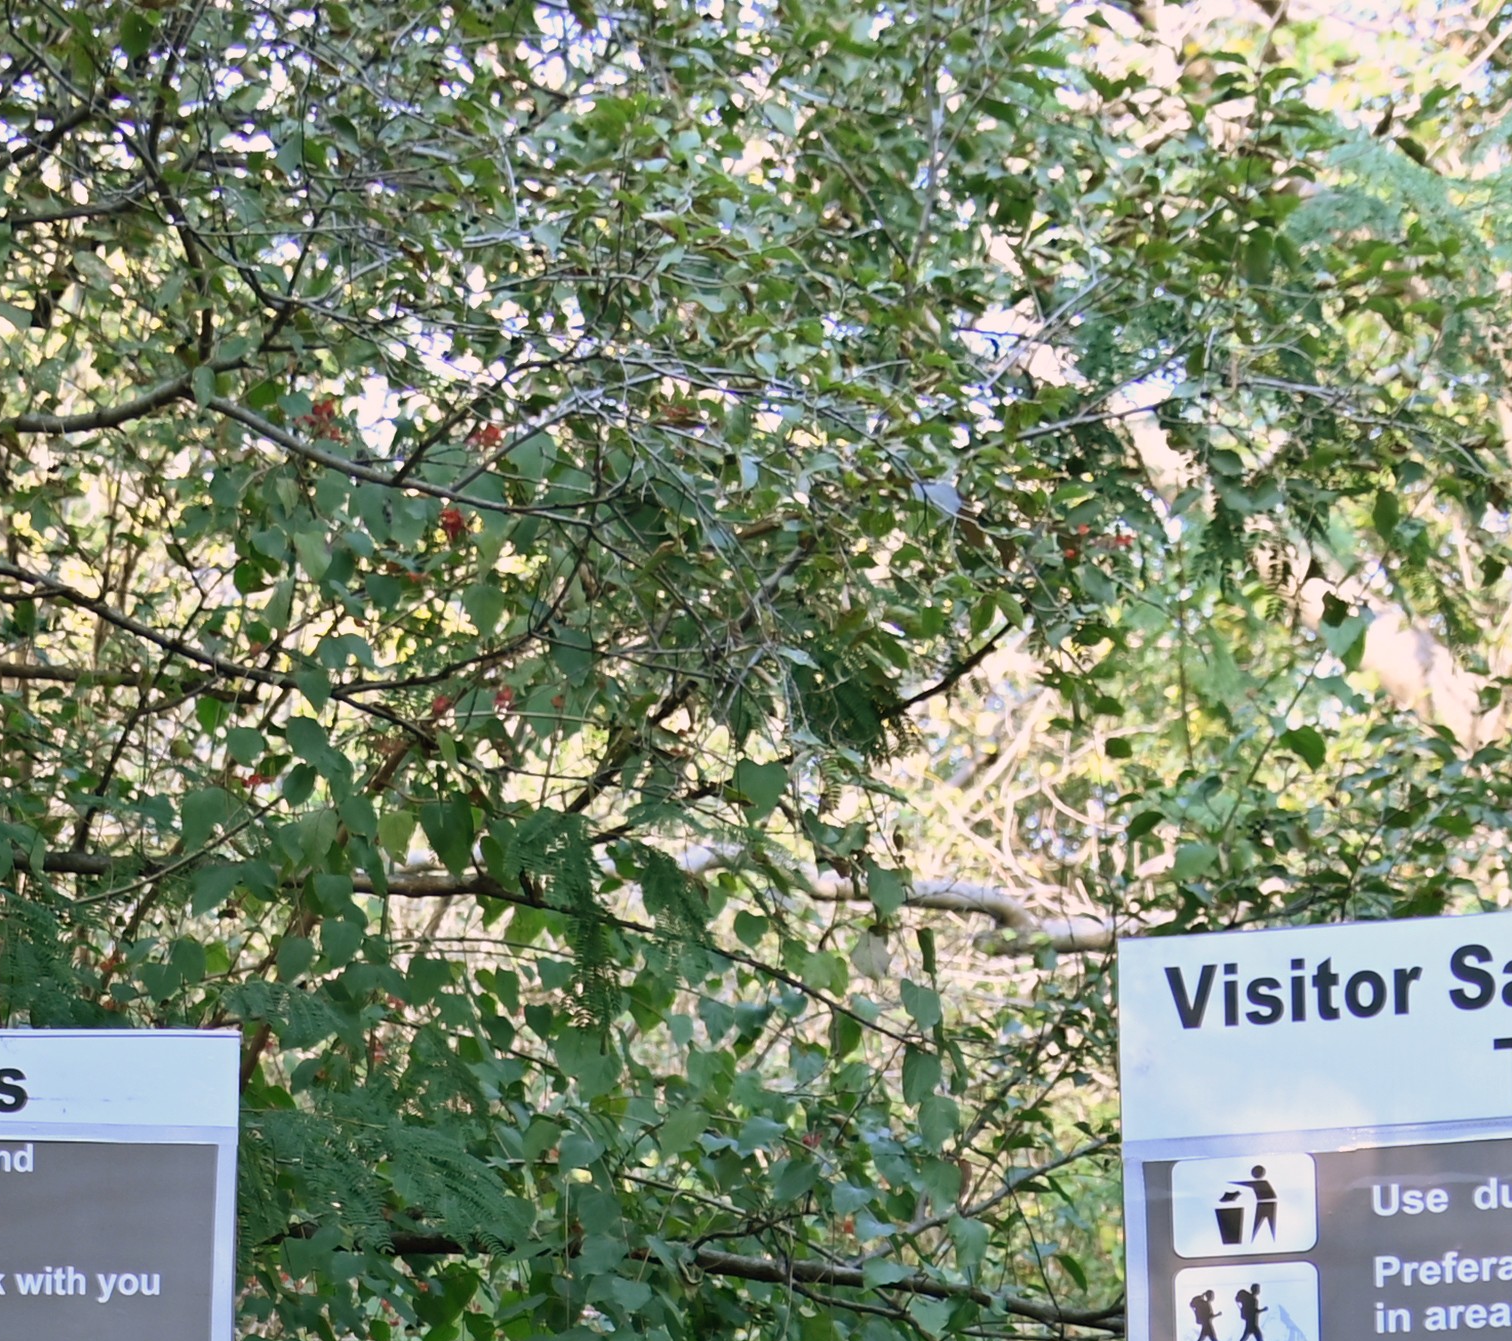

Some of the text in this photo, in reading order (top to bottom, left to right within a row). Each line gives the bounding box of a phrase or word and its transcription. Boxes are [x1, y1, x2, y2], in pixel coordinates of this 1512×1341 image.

[1163, 956, 1424, 1031] Visitor
[1372, 1182, 1449, 1217] Use
[1375, 1301, 1411, 1335] in
